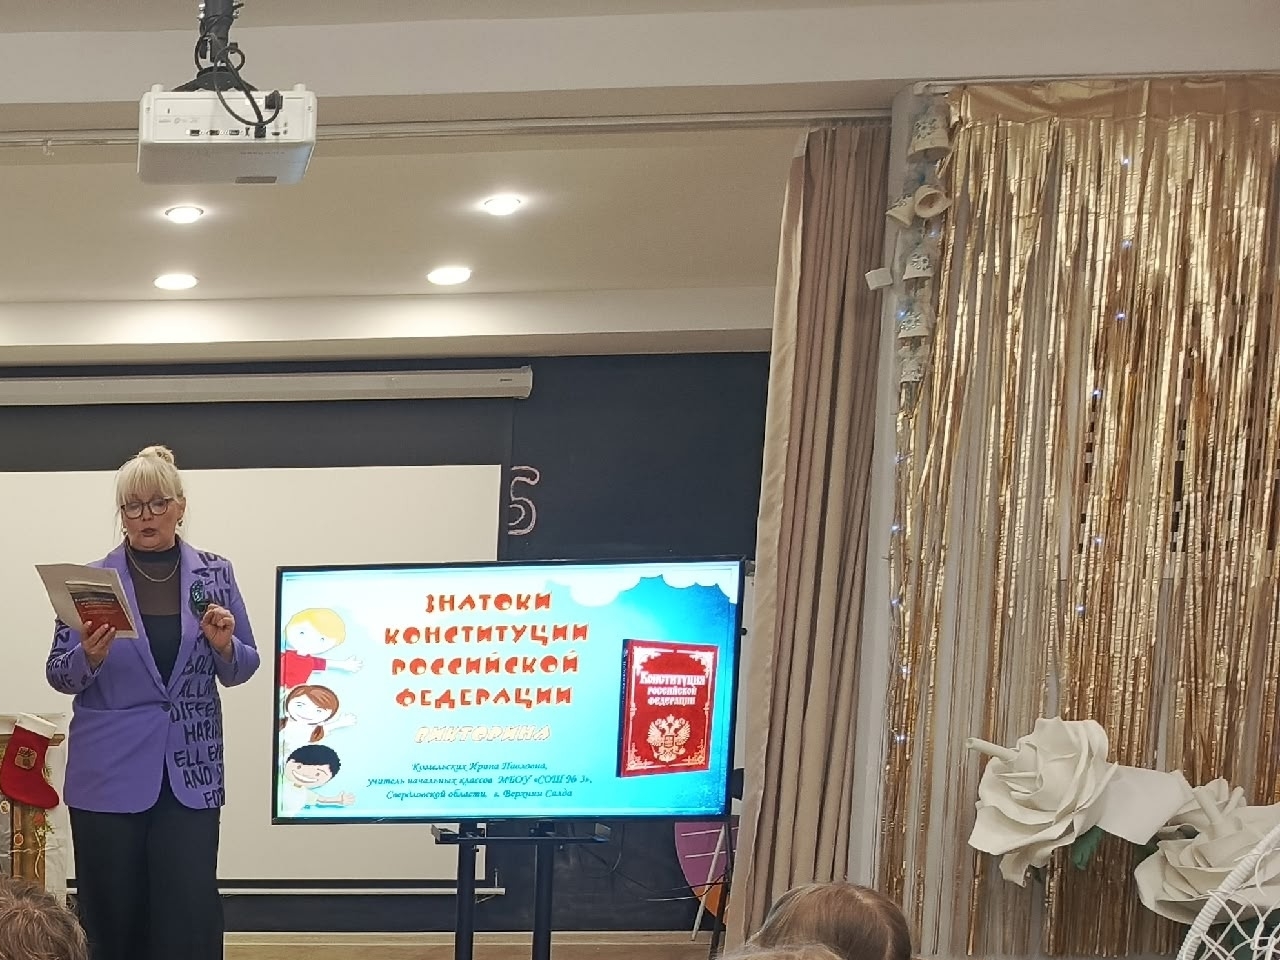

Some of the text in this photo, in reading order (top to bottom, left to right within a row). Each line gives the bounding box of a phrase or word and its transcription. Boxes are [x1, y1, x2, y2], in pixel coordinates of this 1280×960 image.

[425, 592, 552, 613] ЗНАТОКИ
[384, 624, 588, 646] КОНСТИТУЦИИ
[392, 650, 578, 675] РОССИЙСКОЙ
[395, 687, 572, 709] ФЕДЕРАЦИИ
[414, 725, 551, 743] ВИКТОРИНА
[183, 764, 213, 789] AND
[469, 762, 499, 773] Ирина
[367, 777, 405, 787] учитель
[408, 778, 457, 786] начальных
[459, 777, 493, 786] классов
[498, 775, 532, 785] МБОУ
